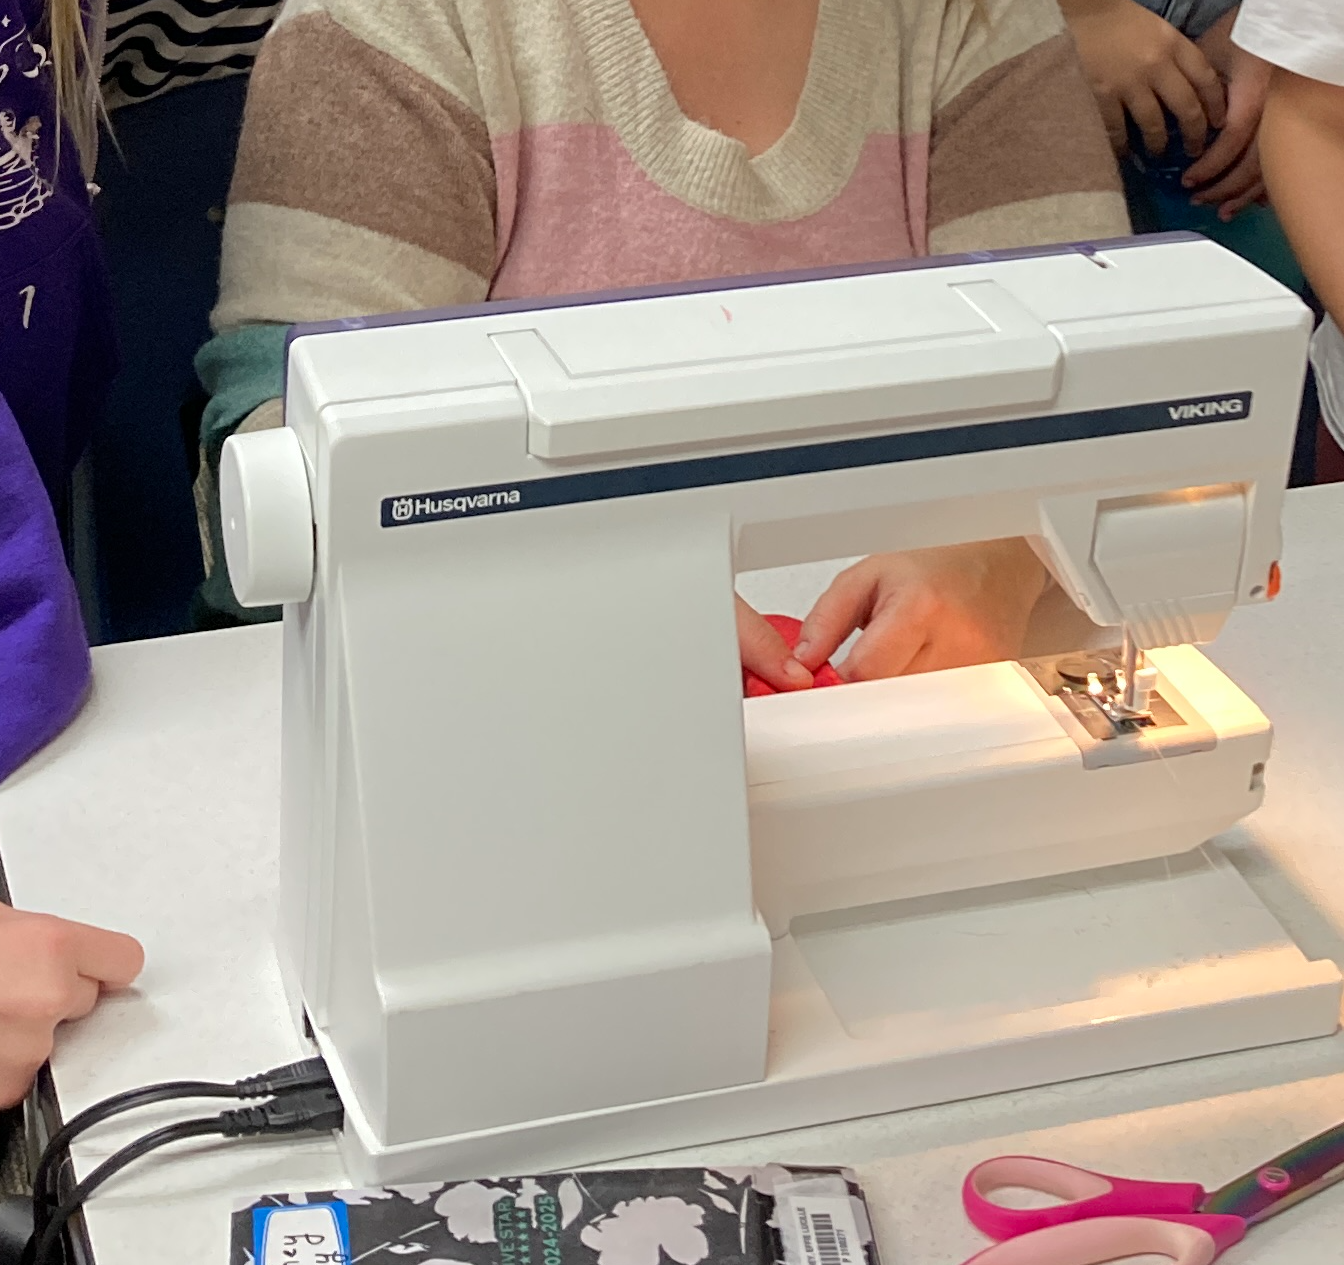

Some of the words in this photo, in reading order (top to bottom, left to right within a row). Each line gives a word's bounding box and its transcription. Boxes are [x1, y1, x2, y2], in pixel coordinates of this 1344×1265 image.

[1167, 398, 1244, 421] VIKING
[415, 490, 521, 515] Husqvarna
[497, 1201, 514, 1240] STAR
[538, 1195, 562, 1265] 024-2025
[499, 1242, 517, 1265] IVE
